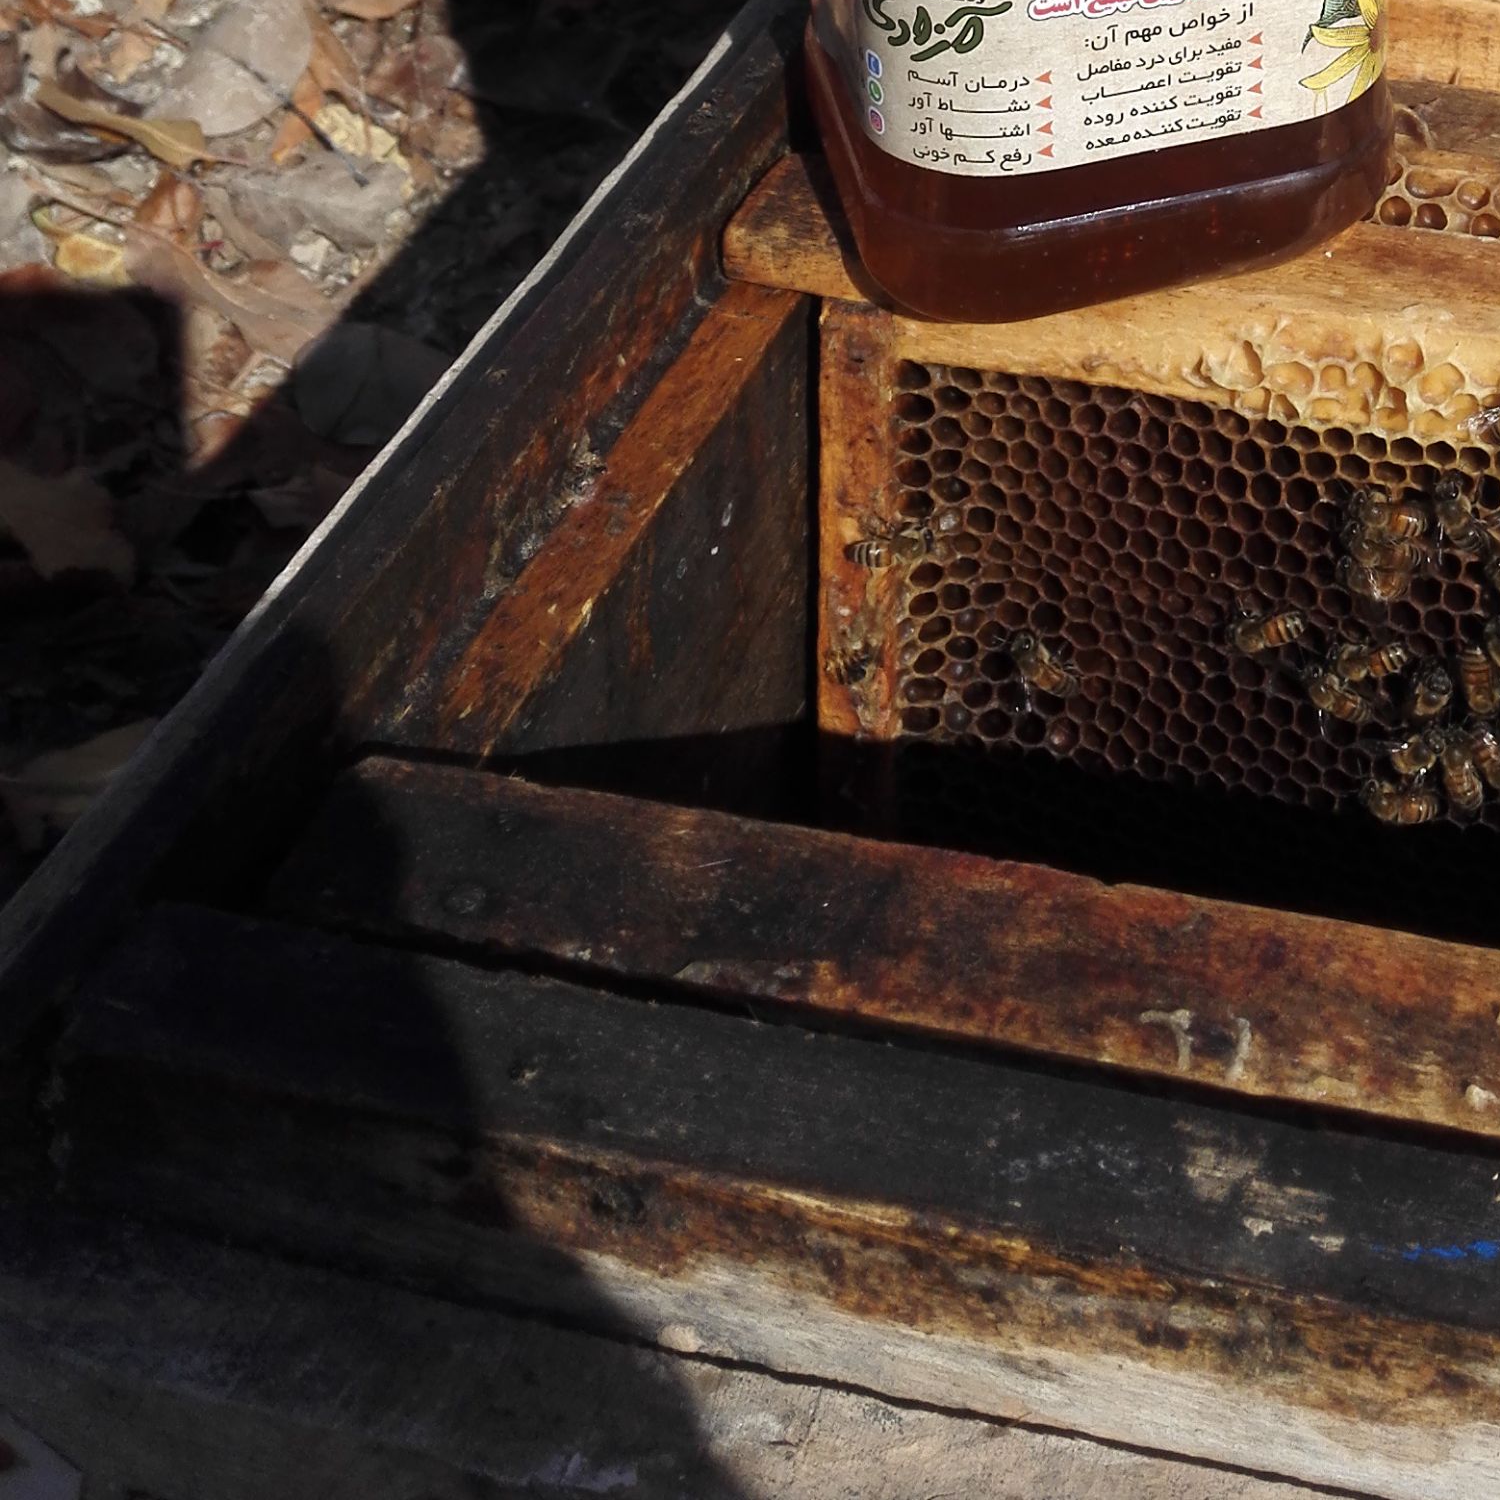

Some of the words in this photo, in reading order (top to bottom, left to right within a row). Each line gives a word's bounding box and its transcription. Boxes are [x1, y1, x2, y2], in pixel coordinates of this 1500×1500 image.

[1236, 2, 1254, 25] از
[1168, 10, 1231, 37] خواص
[1125, 25, 1162, 45] مهم
[1205, 37, 1242, 55] مفید
[1135, 55, 1165, 70] درد
[1168, 46, 1203, 66] برای
[907, 69, 958, 87] آسم
[1076, 59, 1132, 81] مفاصل
[1178, 61, 1242, 84] تقویت
[964, 76, 1030, 93] درمان
[1081, 75, 1172, 105] اعصاب
[908, 92, 932, 109] آور
[1184, 85, 1242, 107] تقویت
[937, 98, 1031, 114] نشاط
[1130, 96, 1178, 117] کننده
[910, 117, 934, 134] آور
[1084, 112, 1125, 127] روده
[1186, 110, 1242, 131] تقویت
[939, 122, 1030, 141] اشتها
[1133, 119, 1183, 140] کننده
[1085, 133, 1131, 151] معده
[913, 145, 950, 163] خونی
[953, 150, 995, 165] کم
[1000, 151, 1032, 171] رفع
